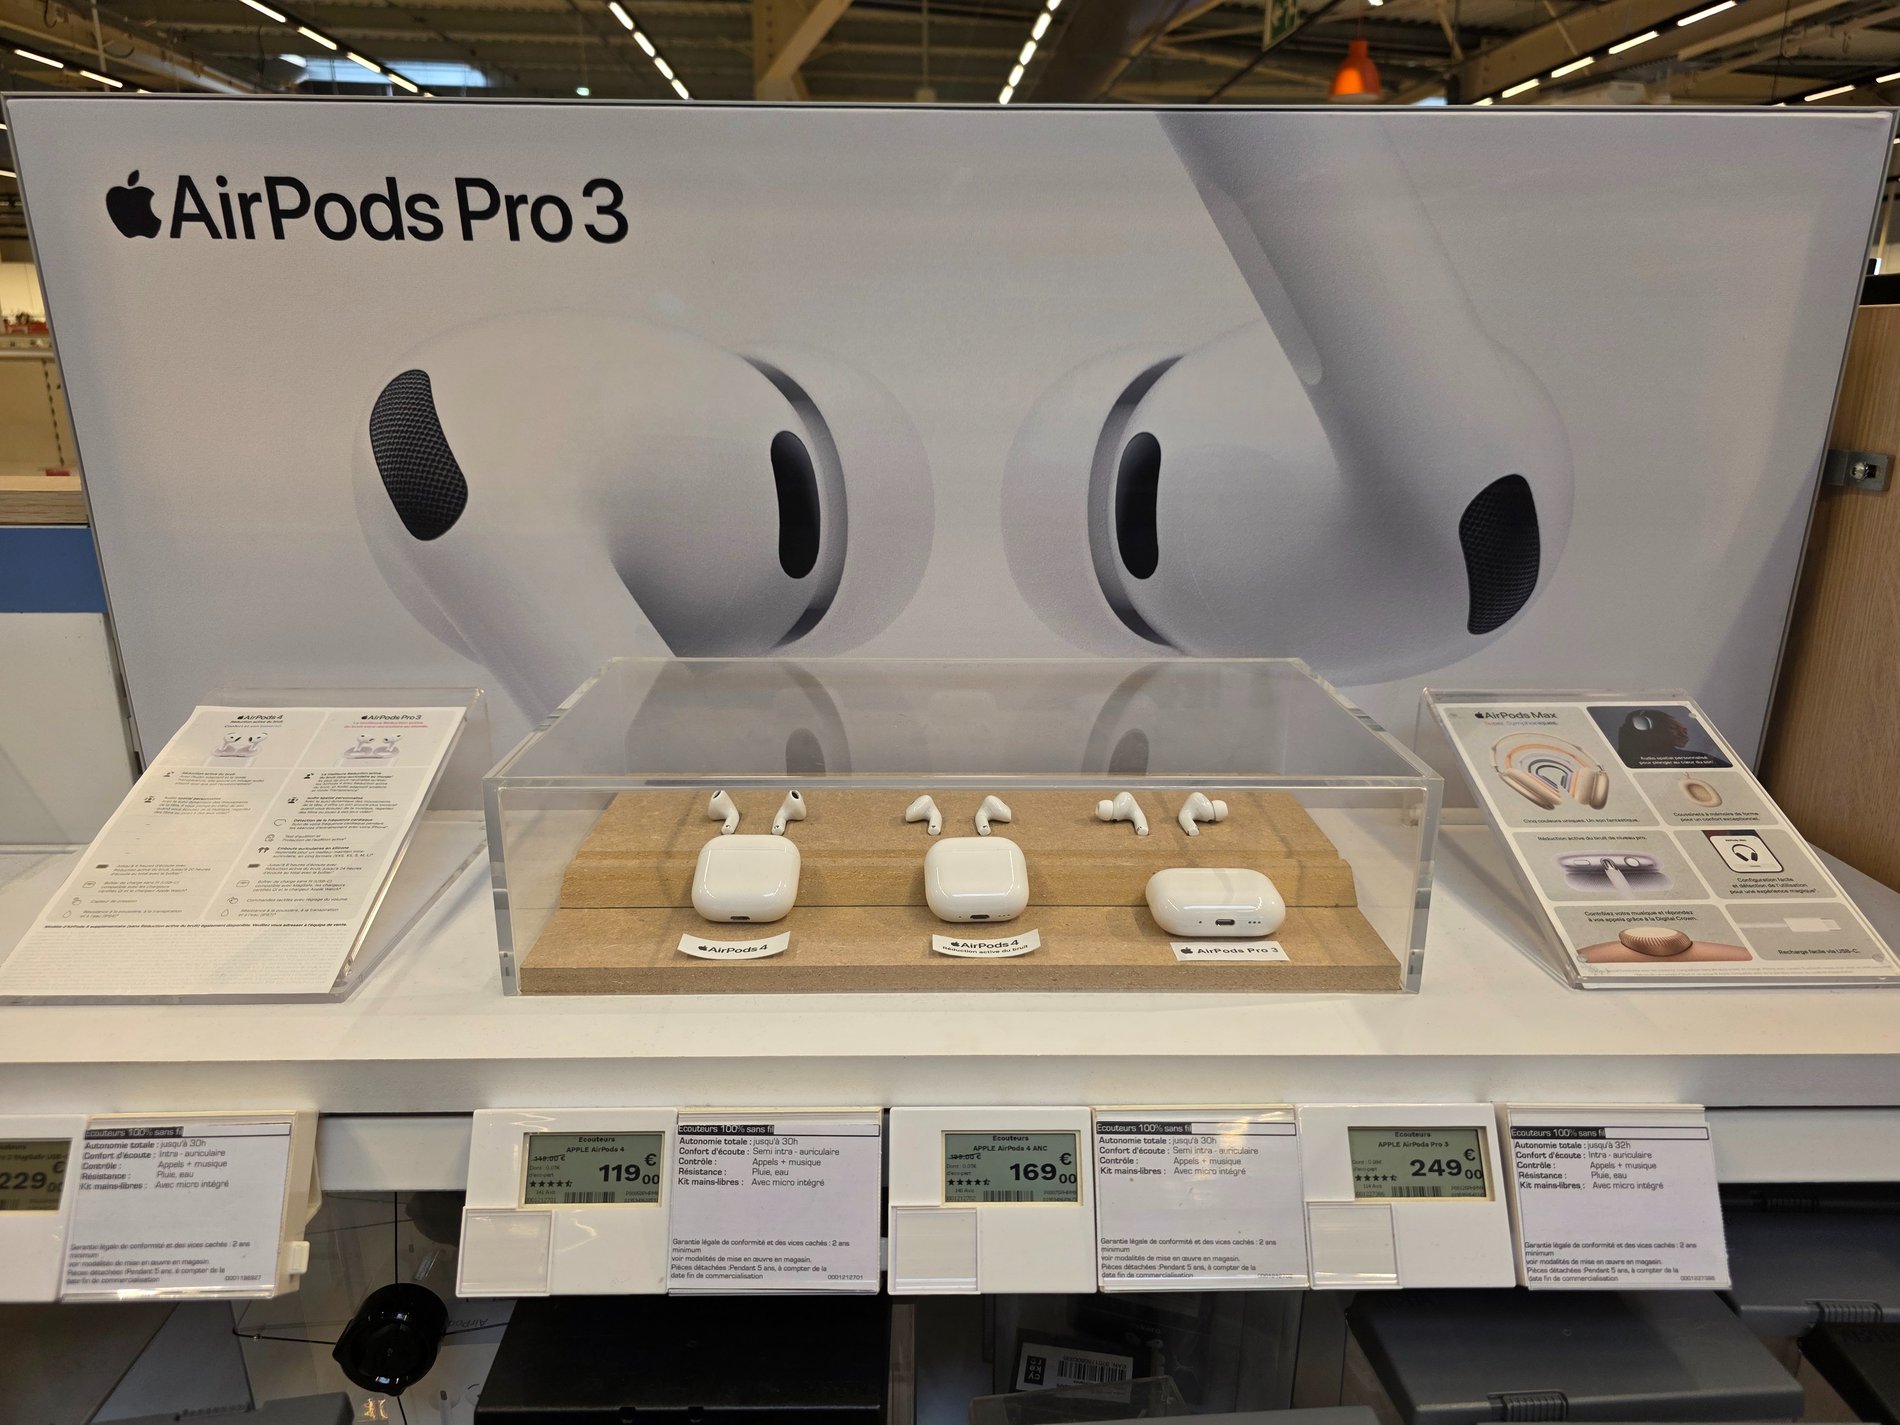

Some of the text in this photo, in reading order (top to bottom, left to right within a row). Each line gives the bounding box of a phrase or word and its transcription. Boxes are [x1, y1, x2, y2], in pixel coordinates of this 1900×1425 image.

[170, 175, 628, 243] AirPods Pro 3
[678, 1125, 718, 1133] Ecouteurs
[721, 1125, 745, 1133] 100%
[1097, 1124, 1137, 1133] Ecouteurs
[1139, 1124, 1163, 1133] 100%
[1511, 1129, 1551, 1137] Ecouteurs
[1553, 1128, 1577, 1137] 100%
[84, 1138, 207, 1150] Autonomie totale jusqu'à 30h
[753, 1137, 780, 1147] jusqu'à
[1143, 1137, 1167, 1145] totale
[1172, 1136, 1199, 1146] jusqu'à
[1201, 1137, 1217, 1145] 30h
[1514, 1141, 1557, 1149] Autonomie
[1587, 1141, 1613, 1150] jusqu'à
[1615, 1141, 1631, 1149] 32h
[711, 1148, 745, 1156] d'écoute
[752, 1148, 773, 1156] Semi
[774, 1148, 793, 1156] intra
[799, 1148, 840, 1156] auriculaire
[1516, 1151, 1652, 1159] Confort d'écoute Intra auriculaire
[678, 1157, 713, 1165] Contrôle
[752, 1158, 779, 1167] Appels
[788, 1159, 821, 1167] musique
[1409, 1148, 1483, 1180] 249 € 00
[599, 1153, 660, 1185] 119 € 00
[678, 1168, 722, 1176] Résistance
[752, 1168, 773, 1177] Pluie,
[1009, 1152, 1077, 1184] 169 € 00
[1114, 1167, 1162, 1175] mains-libres
[1173, 1167, 1193, 1175] Avec
[1219, 1167, 1246, 1176] intégré
[0, 1172, 47, 1189] 229
[80, 1179, 229, 1191] Kit mains-libres Avec micro intégré
[691, 1178, 740, 1186] mains-libres
[797, 1179, 825, 1188] intégré
[1637, 1182, 1664, 1191] intégré
[672, 1238, 700, 1246] Garantie
[702, 1239, 720, 1247] légale
[805, 1239, 828, 1247] cachés
